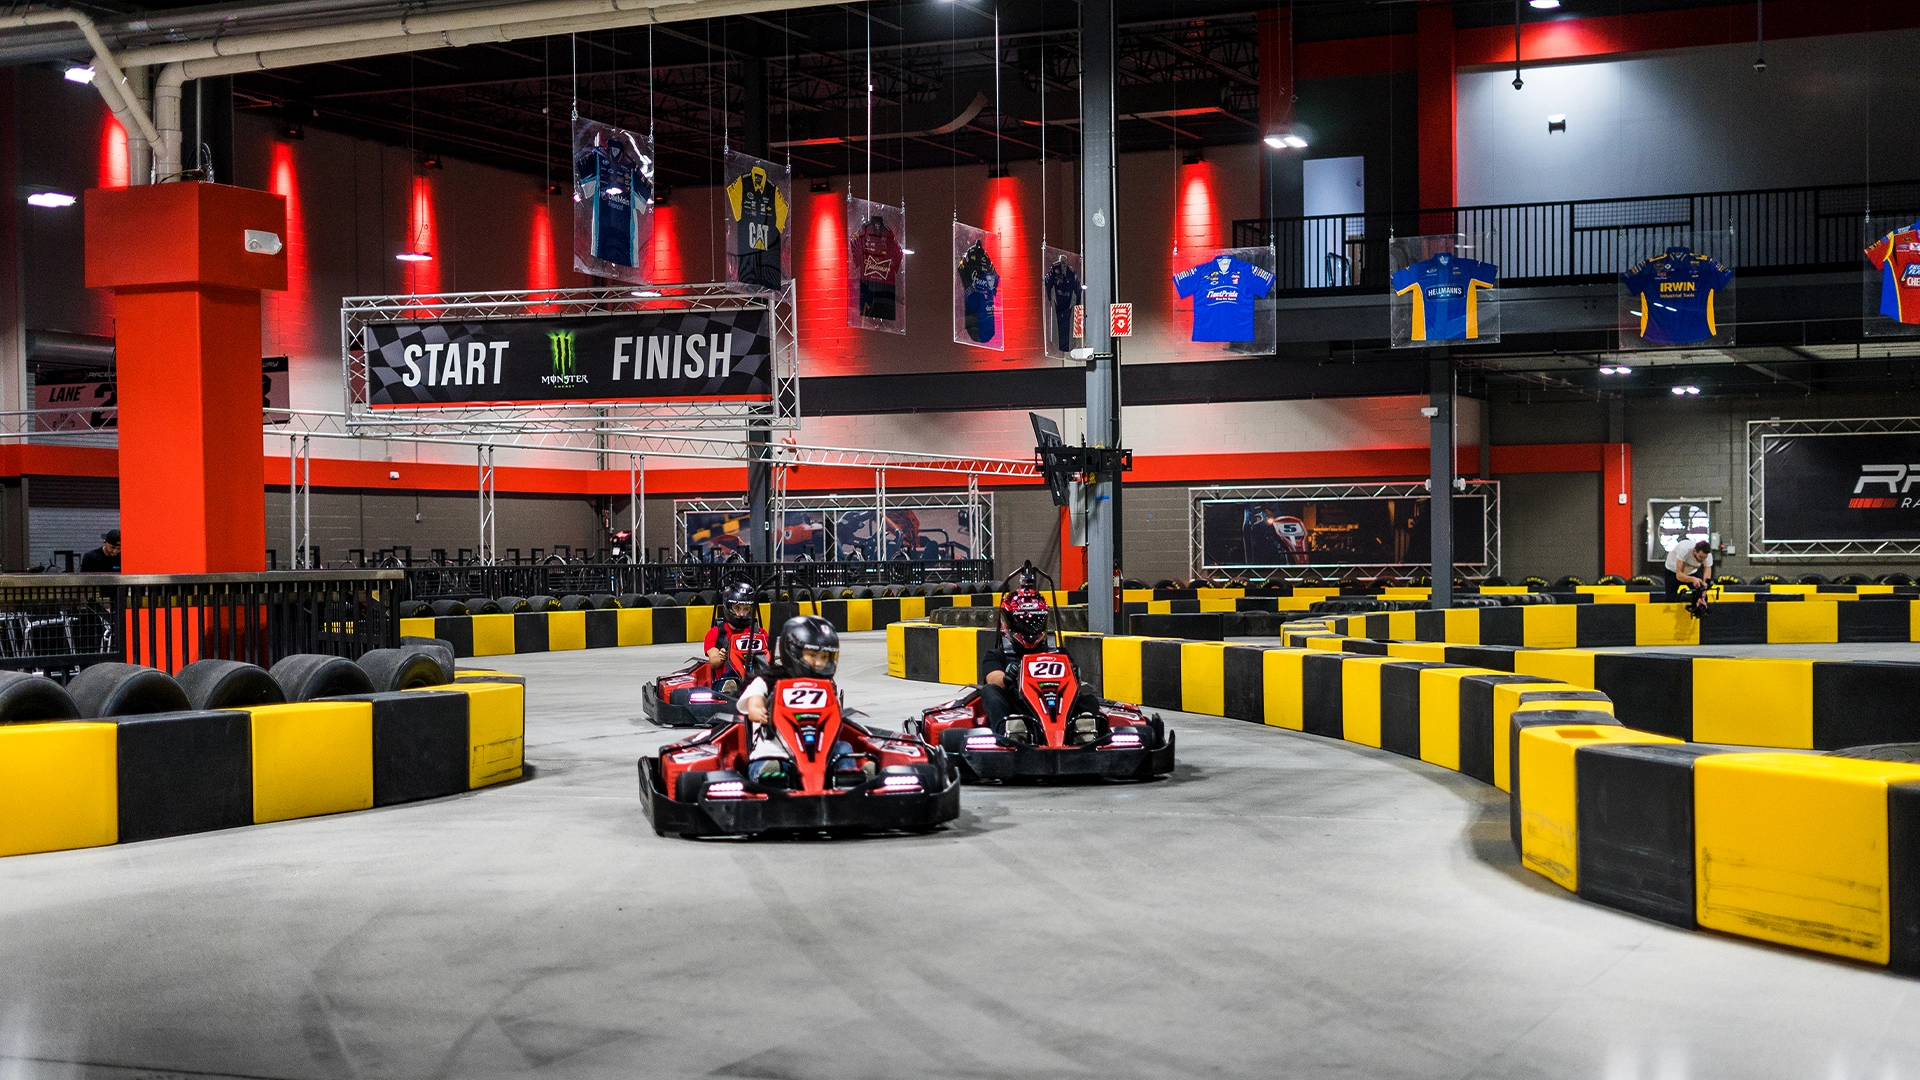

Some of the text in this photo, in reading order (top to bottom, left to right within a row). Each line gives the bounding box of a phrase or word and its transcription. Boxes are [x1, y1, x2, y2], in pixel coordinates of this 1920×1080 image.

[748, 222, 769, 251] CAT
[1660, 281, 1695, 292] IRWIN
[402, 333, 733, 388] START FINISH
[541, 374, 589, 385] MONSTER
[49, 385, 86, 403] LANE
[1283, 523, 1298, 533] 5
[1034, 662, 1062, 676] 20
[789, 689, 824, 705] 27
